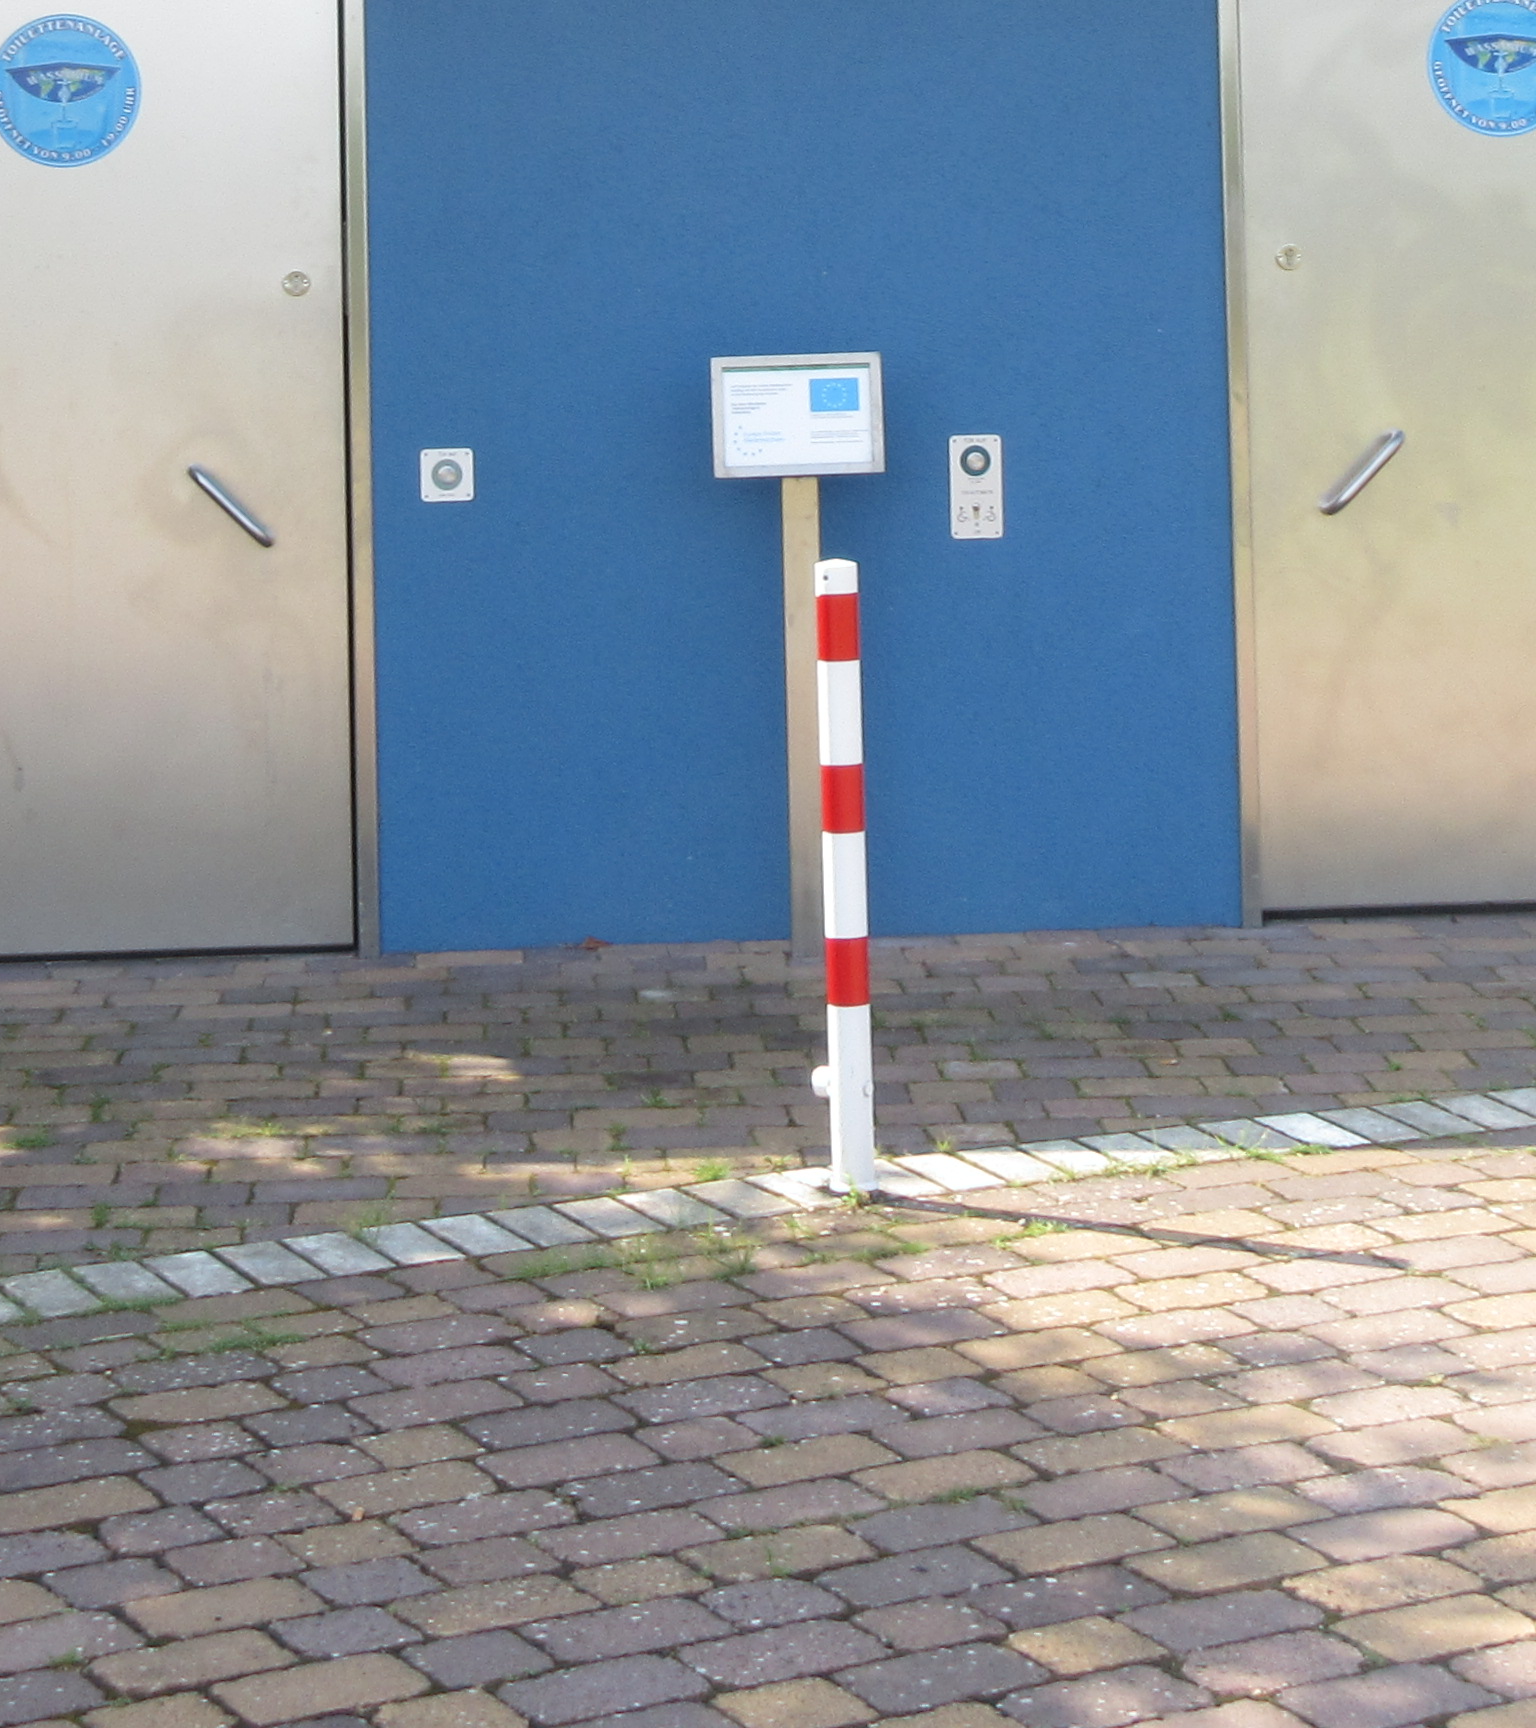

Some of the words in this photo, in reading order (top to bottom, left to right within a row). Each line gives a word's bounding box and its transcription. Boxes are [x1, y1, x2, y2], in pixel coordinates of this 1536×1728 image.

[1, 20, 127, 62] TOILETTENANLAGE
[1471, 116, 1496, 129] VON
[32, 147, 58, 159] VON
